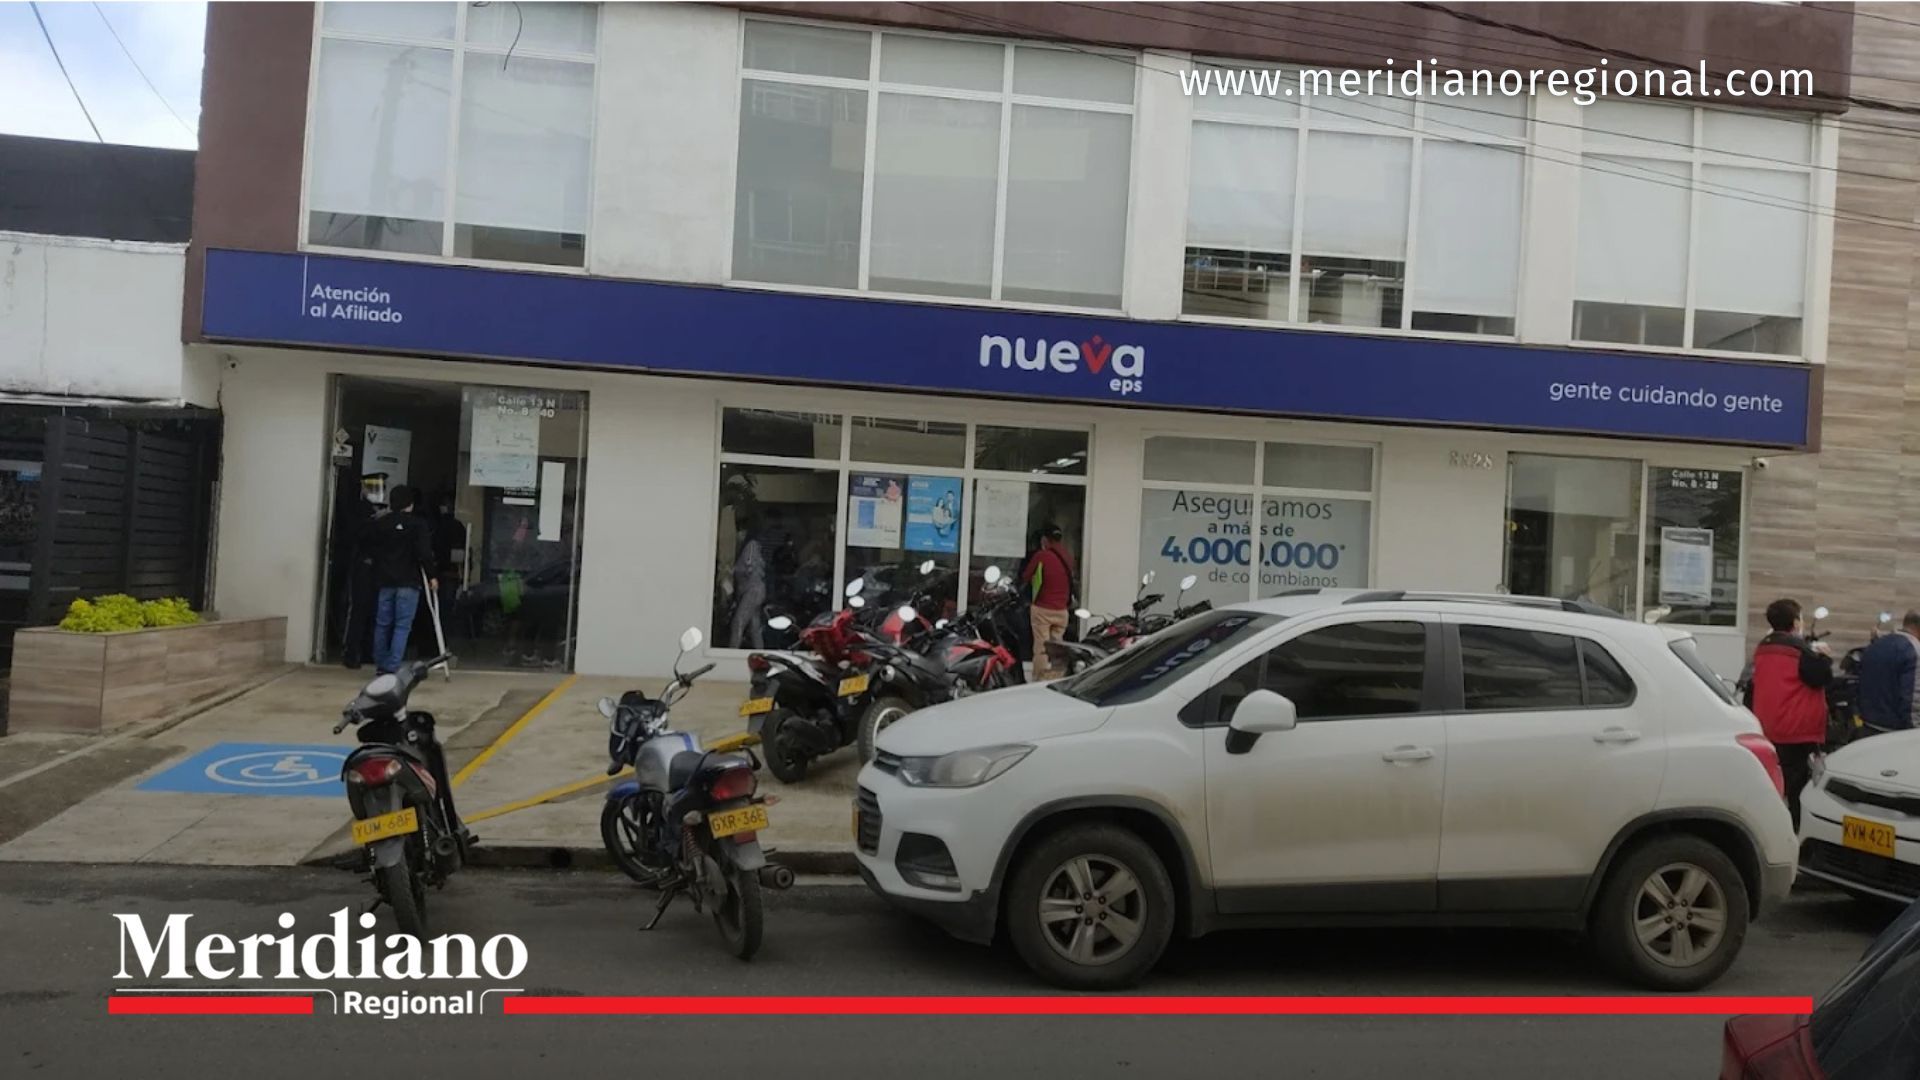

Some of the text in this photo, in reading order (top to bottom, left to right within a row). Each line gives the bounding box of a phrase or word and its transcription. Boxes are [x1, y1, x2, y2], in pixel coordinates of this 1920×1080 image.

[310, 283, 391, 304] Atención
[310, 302, 403, 323] al Afiliado
[979, 334, 1145, 378] nueva
[1109, 378, 1143, 396] eps
[1549, 381, 1784, 413] gente cuidando gente
[498, 395, 527, 407] Calle
[545, 398, 556, 409] N
[498, 405, 518, 415] No.
[540, 408, 555, 418] 40
[1672, 469, 1696, 479] Calle
[1711, 471, 1719, 480] N
[1172, 490, 1333, 520] Aseguramos
[1207, 520, 1295, 537] a más de
[1207, 567, 1338, 589] de colombianos
